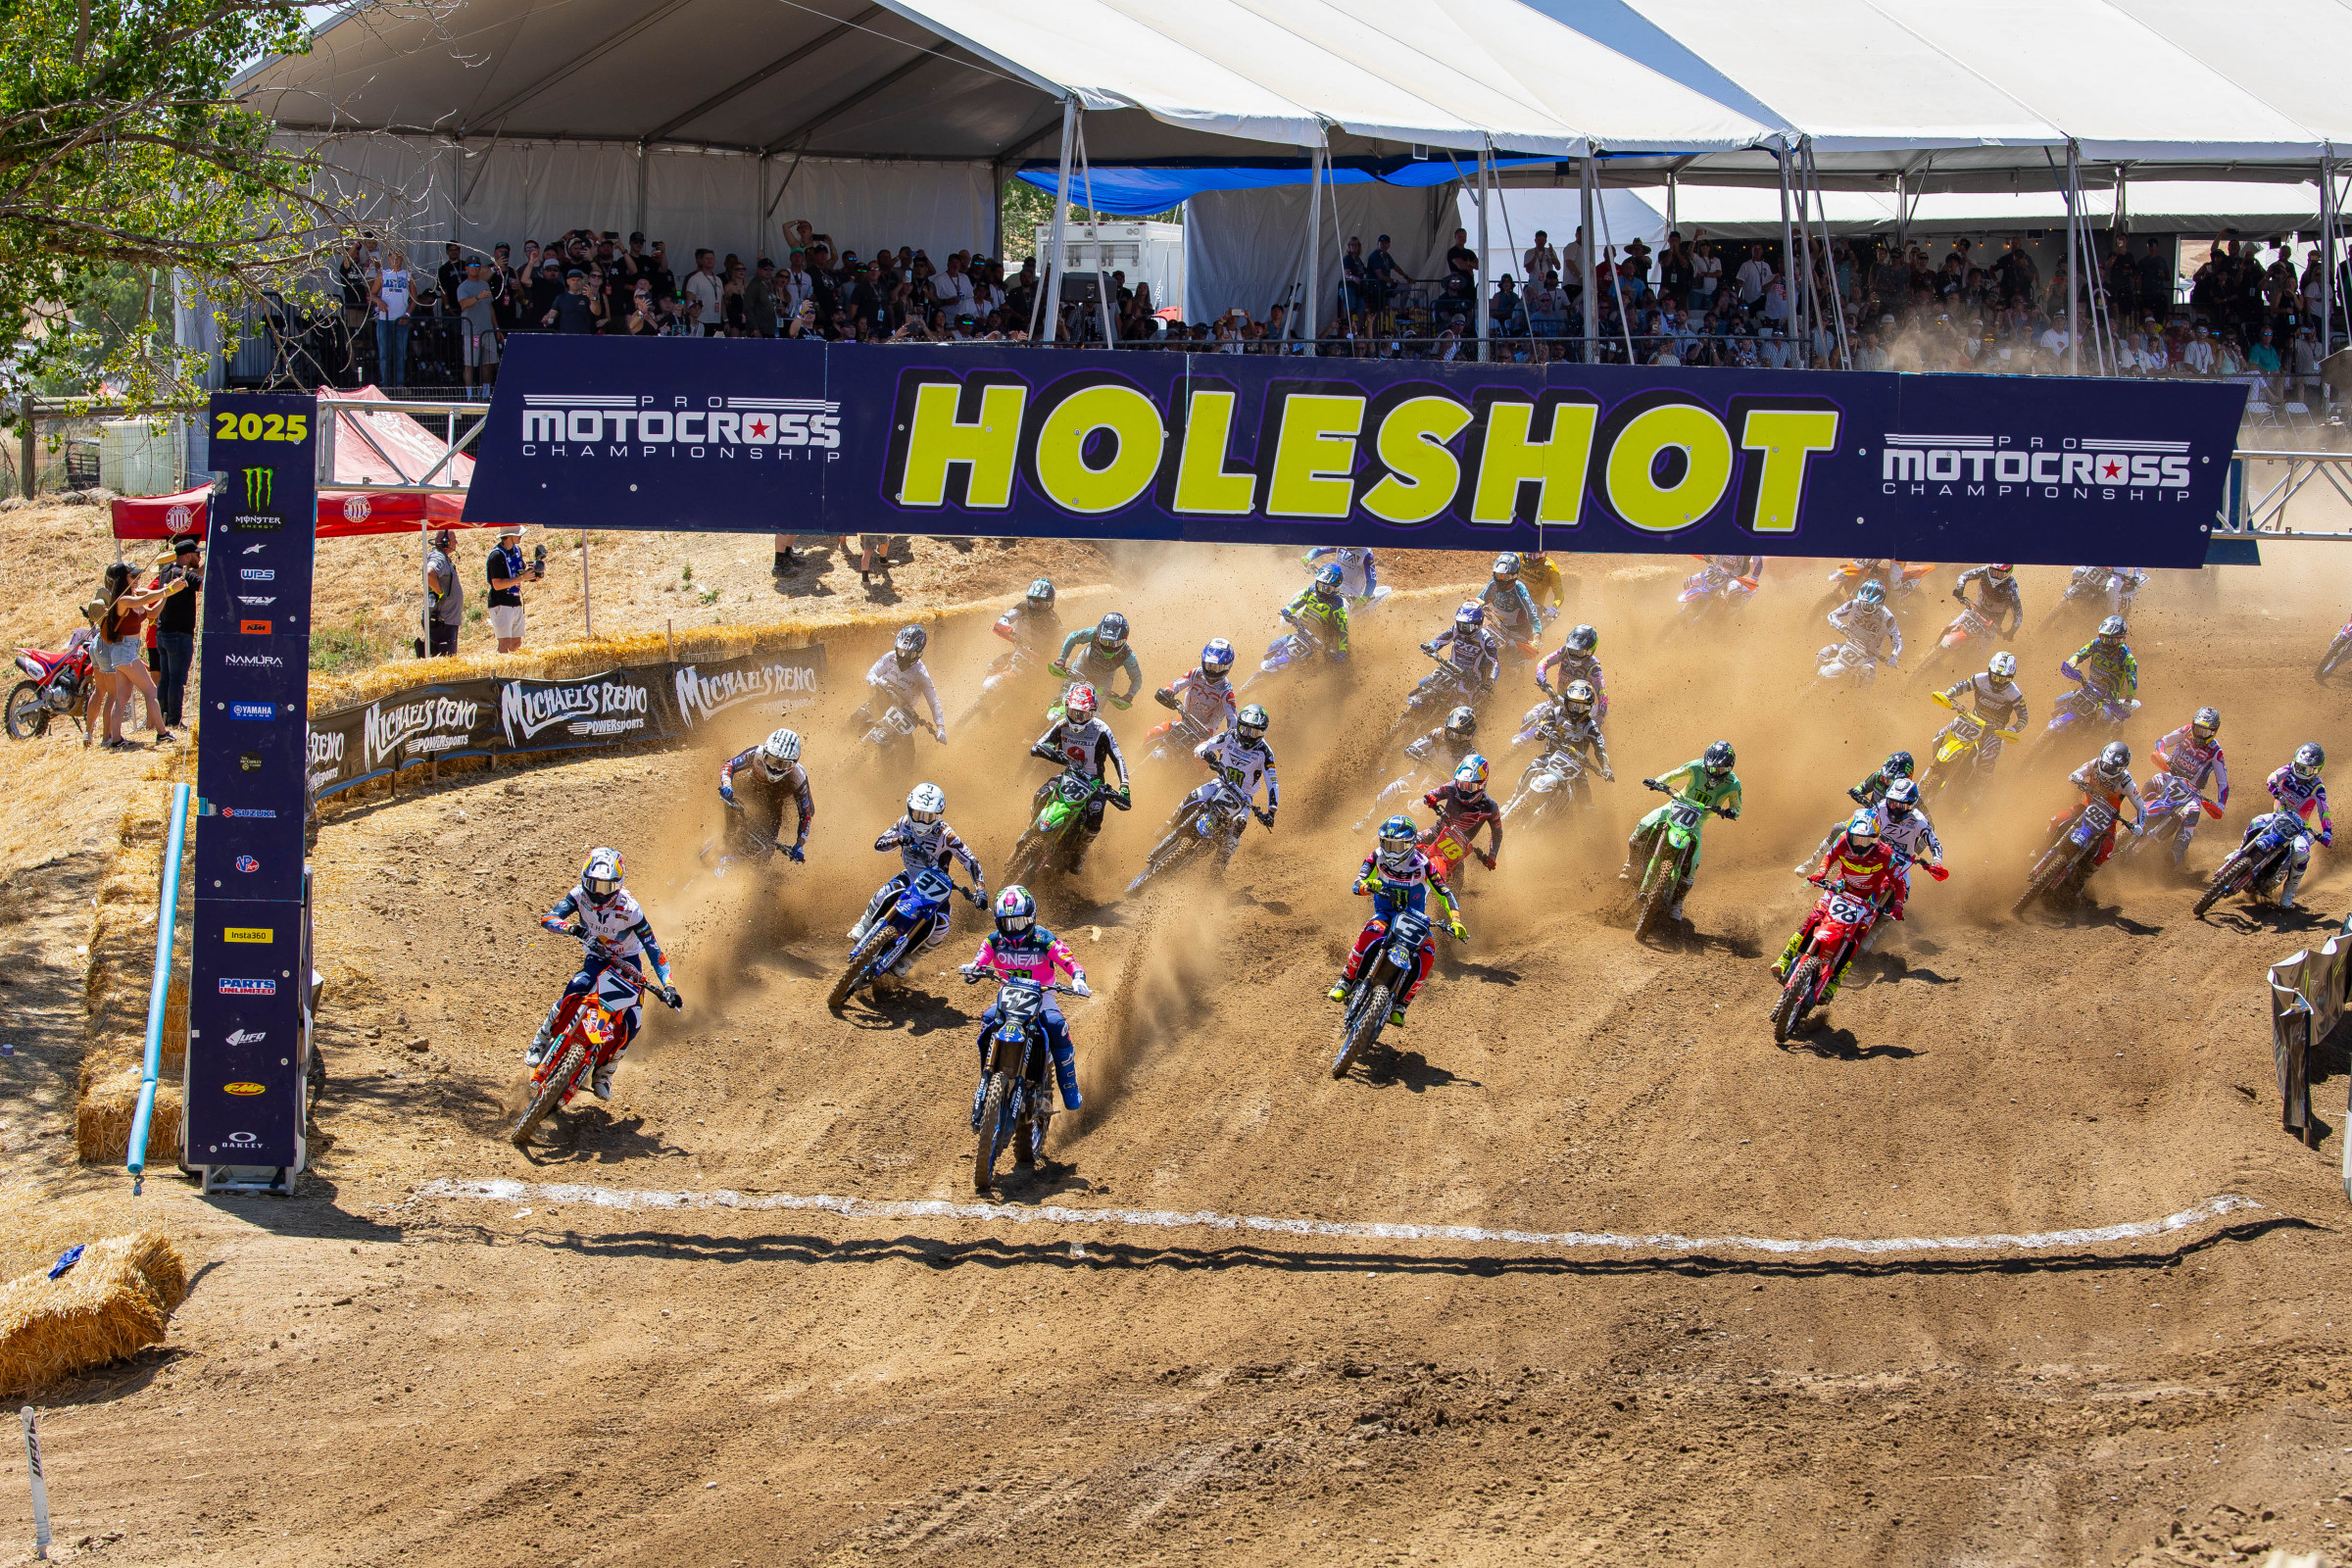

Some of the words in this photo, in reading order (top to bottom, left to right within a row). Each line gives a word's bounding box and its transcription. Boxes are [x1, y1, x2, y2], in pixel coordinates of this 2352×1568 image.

[642, 396, 723, 409] PRO
[216, 412, 308, 441] 2025
[522, 410, 840, 449] MOTOCROSS
[1998, 436, 2077, 450] PRO
[522, 444, 840, 463] CHAMPIONSHIP
[899, 382, 1839, 533] HOLESHOT
[1883, 449, 2191, 487] MOTOCROSS
[1883, 482, 2189, 502] CHAMPIONSHIP
[235, 515, 281, 524] MONSTER
[241, 569, 275, 580] WPS
[246, 623, 266, 632] KTM
[225, 654, 283, 665] NAMURA
[774, 664, 817, 694] RENO
[242, 706, 272, 714] YAMAHA
[502, 680, 600, 749] MICHAEL'S
[602, 682, 648, 713] RENO
[365, 699, 436, 774] MICHAEL'S
[434, 697, 478, 730] RENO
[1951, 720, 1981, 741] 102
[311, 732, 344, 766] RENO
[2180, 751, 2200, 766] LIQUI
[1549, 758, 1579, 778] 24
[2177, 759, 2196, 773] MOLY
[233, 808, 276, 818] SUZUKI
[1670, 805, 1699, 827] 70
[1437, 837, 1464, 860] 18
[916, 872, 950, 898] 37
[1832, 903, 1857, 922] 96
[231, 931, 267, 940] Insta360
[1396, 915, 1428, 942] 3
[220, 978, 275, 989] PARTS
[599, 976, 636, 1003] 7
[1002, 988, 1042, 1016] 32
[241, 1032, 267, 1042] UFO
[224, 1083, 265, 1095] FMF
[28, 1435, 44, 1481] UFO
